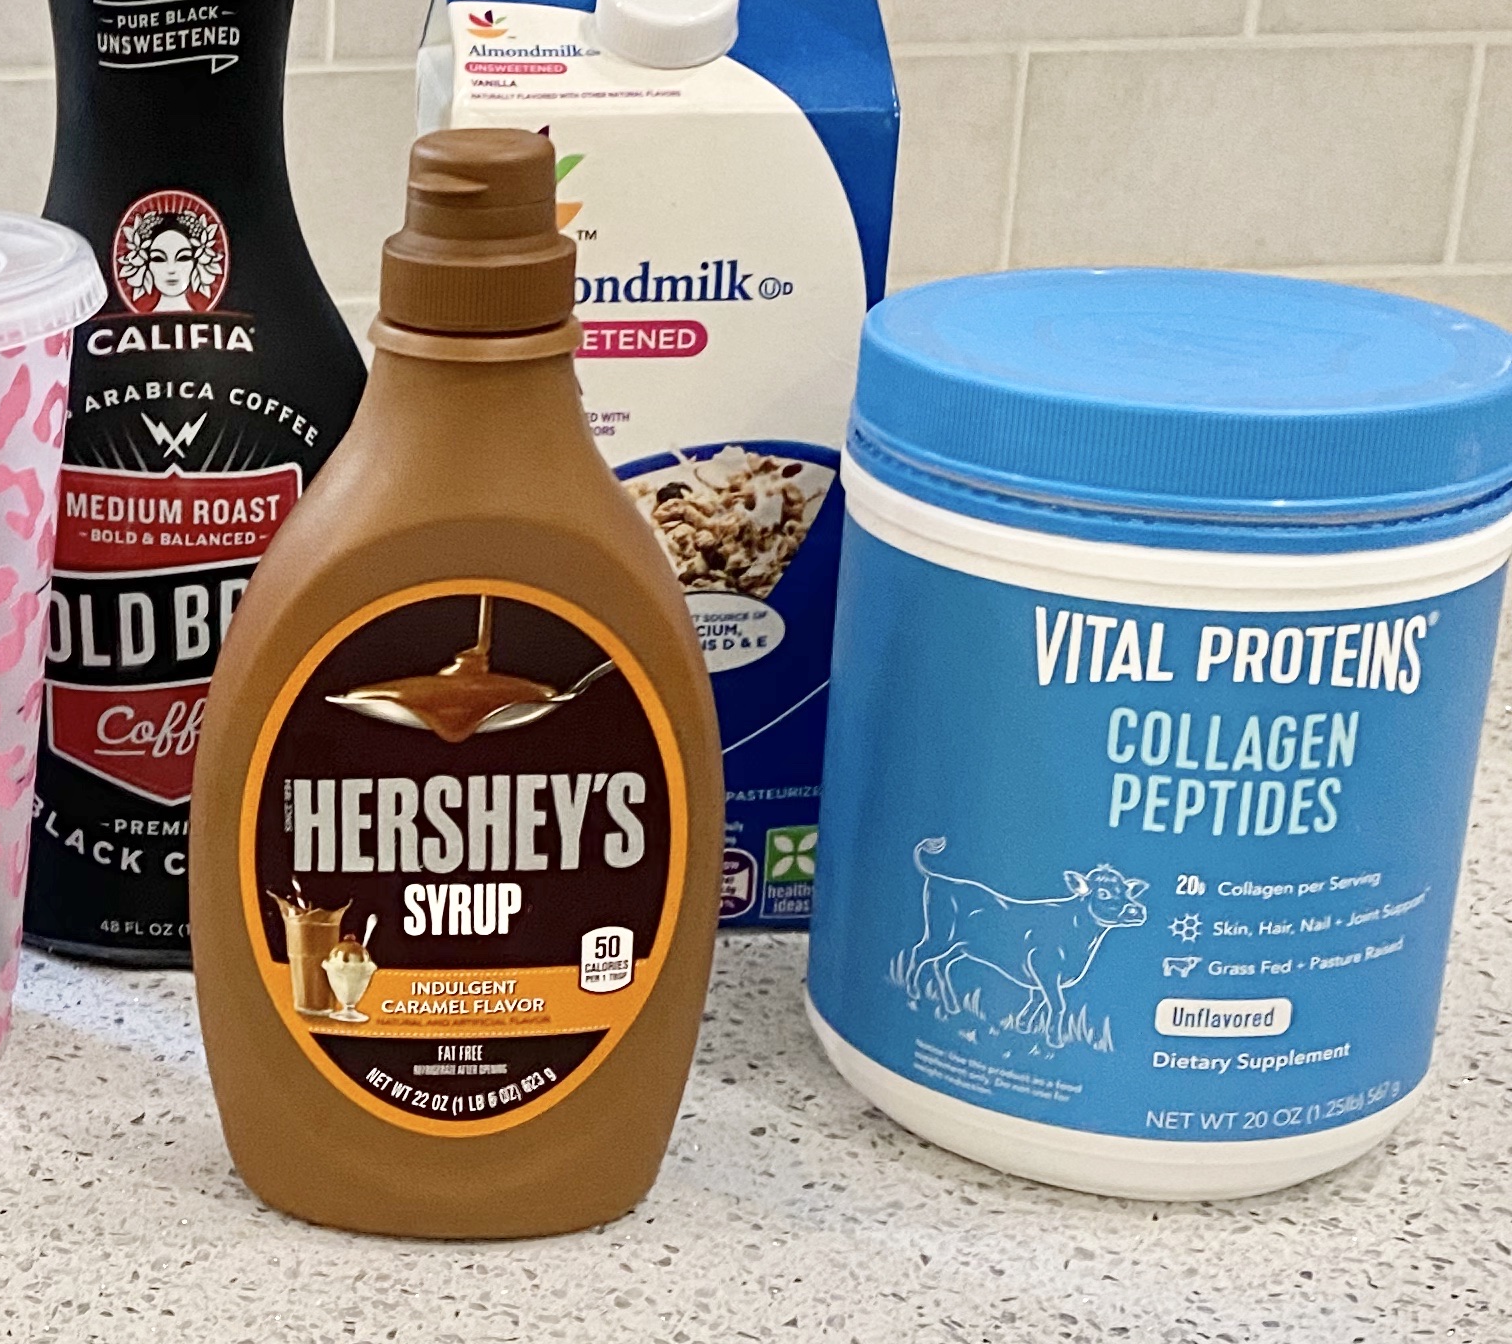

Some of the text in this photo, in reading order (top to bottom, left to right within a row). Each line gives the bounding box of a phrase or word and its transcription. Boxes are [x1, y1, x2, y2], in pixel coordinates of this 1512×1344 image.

[117, 6, 219, 29] PURE BLACK
[97, 26, 240, 55] UNSWEETENED
[469, 44, 583, 57] Almondmilk
[469, 63, 563, 74] UNSWEETENED
[471, 79, 518, 87] VANILLA
[575, 260, 753, 304] ondmilk
[87, 323, 254, 355] CALIFIA
[583, 328, 697, 351] ETENED
[85, 381, 319, 447] ARABICA COFFEE
[602, 412, 630, 422] WITH
[66, 492, 280, 525] MEDIUM ROAST
[91, 529, 256, 546] BOLD & BALANCED
[46, 589, 156, 667] OLD
[696, 624, 742, 637] CIUM,
[723, 639, 735, 650] D
[757, 636, 767, 647] E
[1035, 606, 1427, 695] VITAL PROTEINS
[96, 697, 208, 758] Coff
[1107, 706, 1360, 772] COLLAGEN
[1108, 772, 1342, 836] PEPTIDES
[32, 793, 144, 874] BLACK
[114, 818, 188, 836] PREMI
[294, 771, 646, 874] HERSHEY'S
[768, 884, 814, 899] health
[1217, 881, 1296, 899] Collagen
[1298, 882, 1324, 897] per
[1329, 872, 1382, 891] Serving
[404, 883, 522, 936] SYRUP
[774, 897, 810, 913] ideas
[100, 919, 120, 933] 48
[125, 921, 144, 935] FL
[149, 923, 173, 936] OZ
[1213, 921, 1252, 937] Skin,
[1259, 919, 1295, 936] Hair,
[1300, 915, 1331, 932] Nail
[1346, 909, 1380, 928] Joint
[595, 935, 620, 959] 50
[1208, 961, 1255, 976] Grass
[1260, 960, 1292, 974] Fed
[1310, 952, 1362, 970] Pasture
[1364, 935, 1405, 960] Raised
[585, 959, 629, 973] CALORIES
[411, 980, 517, 995] INDULGENT
[381, 998, 545, 1015] CARAMEL FLAVOR
[1173, 1006, 1275, 1028] Unflavored
[438, 1045, 483, 1061] FAT FREE
[1152, 1042, 1351, 1074] Dietary Supplement
[366, 1067, 393, 1091] NET
[391, 1081, 413, 1101] WT
[412, 1090, 429, 1108] 22
[432, 1094, 449, 1111] OZ
[452, 1096, 463, 1116] (1
[468, 1094, 485, 1112] LB
[544, 1067, 557, 1082] g
[1146, 1110, 1195, 1130] NET
[1200, 1112, 1238, 1130] WT
[1242, 1110, 1268, 1129] 20
[1274, 1106, 1303, 1126] OZ
